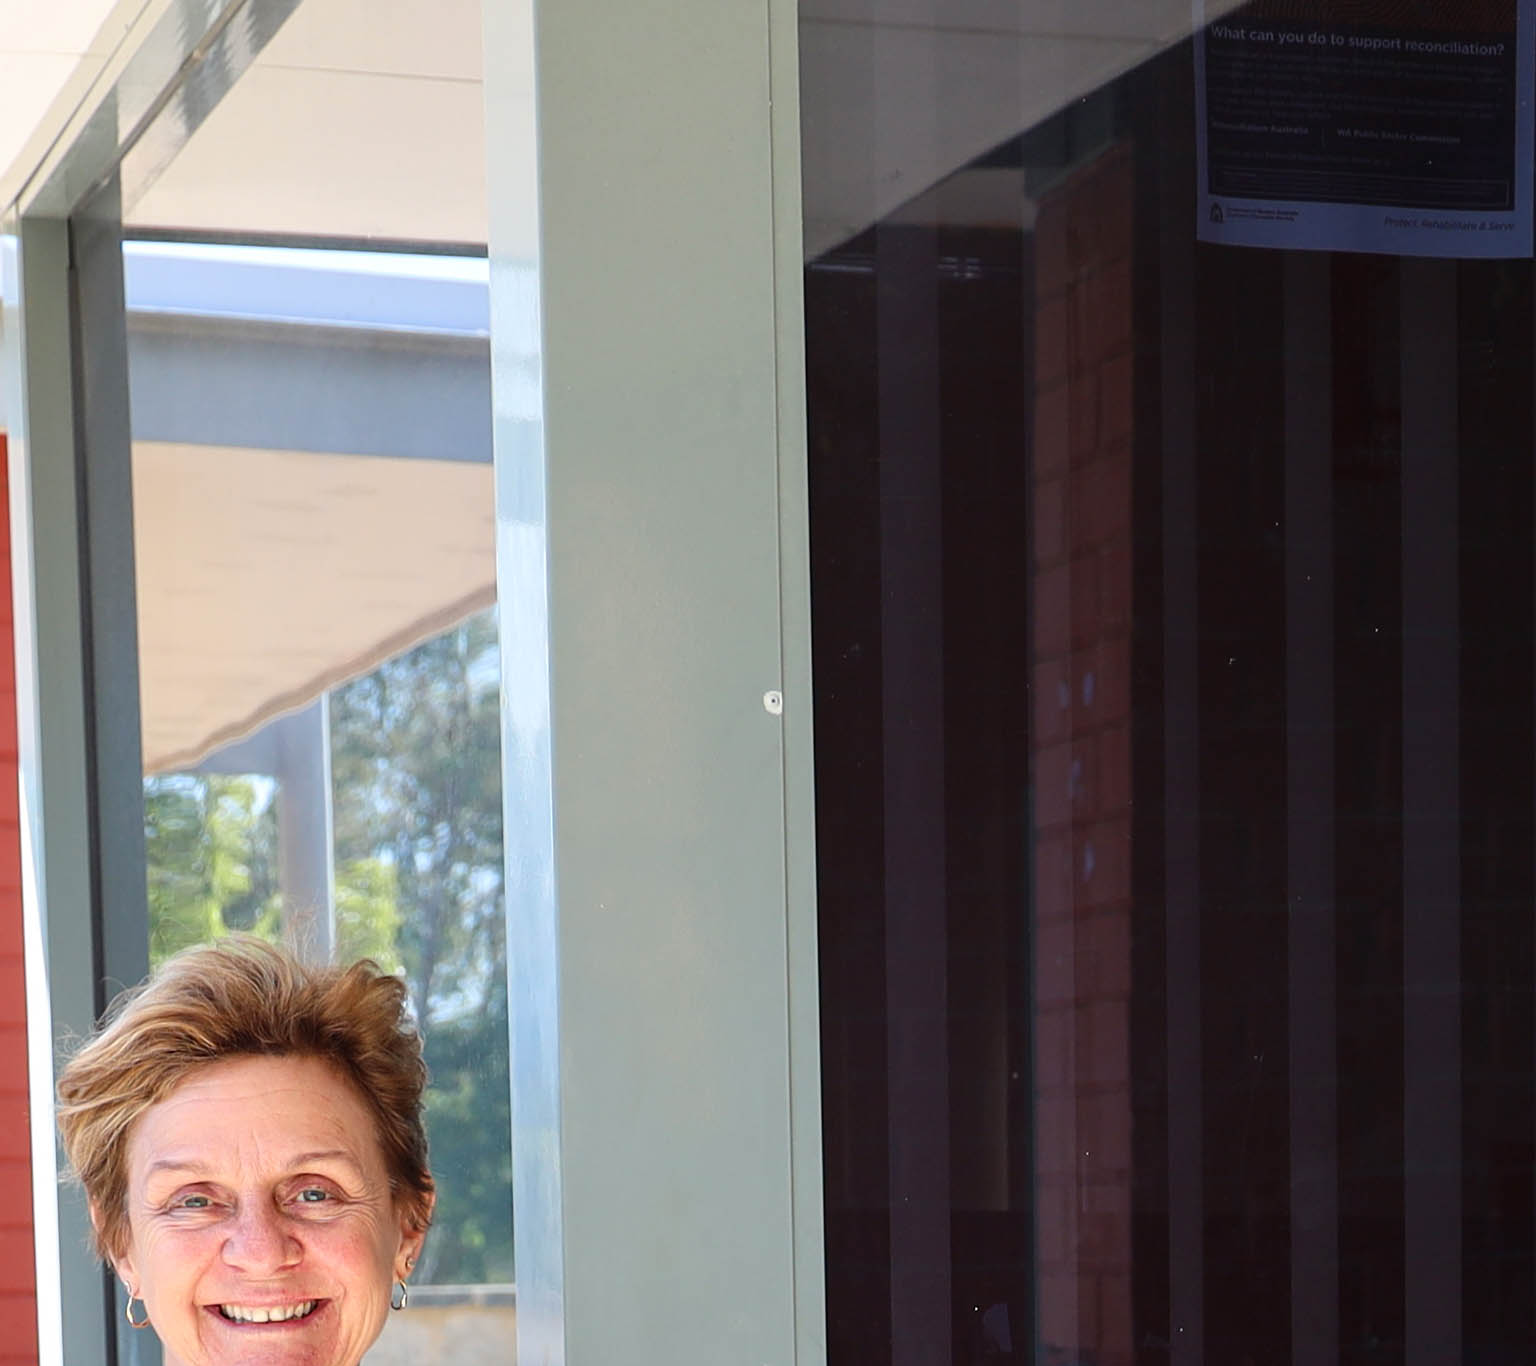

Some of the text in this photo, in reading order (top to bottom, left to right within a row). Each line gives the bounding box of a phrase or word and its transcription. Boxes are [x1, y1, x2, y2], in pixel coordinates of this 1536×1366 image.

[1211, 24, 1505, 57] What can you do to support reconciliation?
